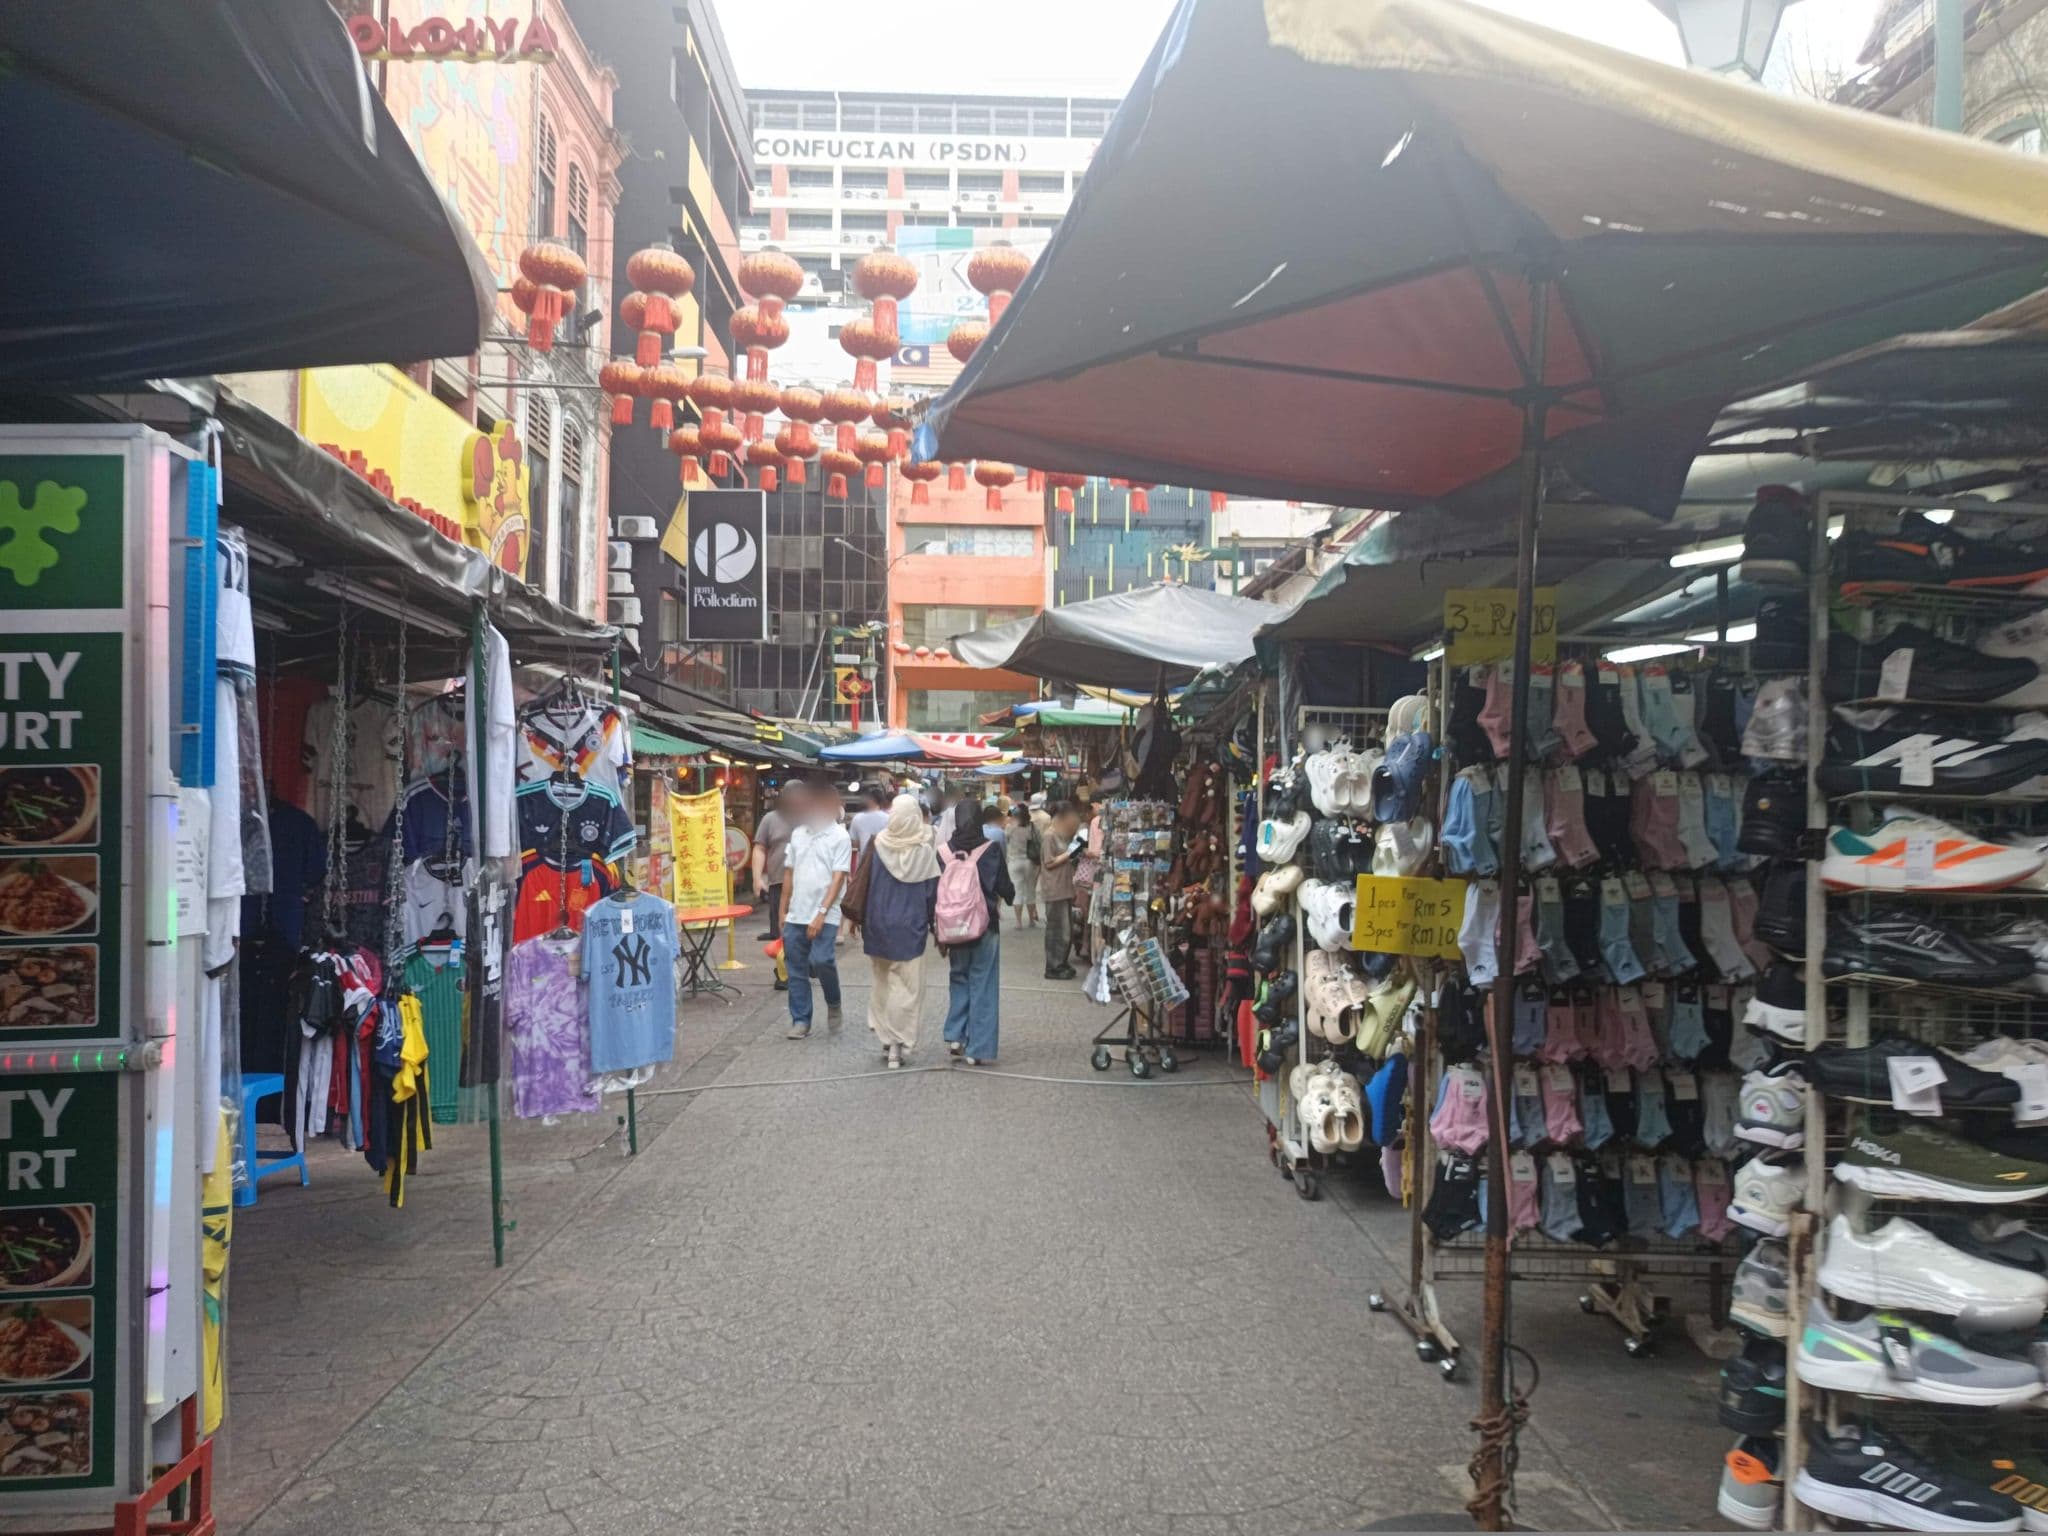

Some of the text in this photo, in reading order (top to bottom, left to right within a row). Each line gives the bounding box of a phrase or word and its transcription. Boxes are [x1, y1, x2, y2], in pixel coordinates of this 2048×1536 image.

[754, 138, 915, 160] CONFUCIAN
[1449, 603, 1469, 632] 3
[1532, 604, 1555, 635] 10
[0, 710, 83, 750] RT
[1440, 899, 1451, 916] 5
[1437, 925, 1456, 947] 10
[1851, 1136, 1901, 1166] HOKA
